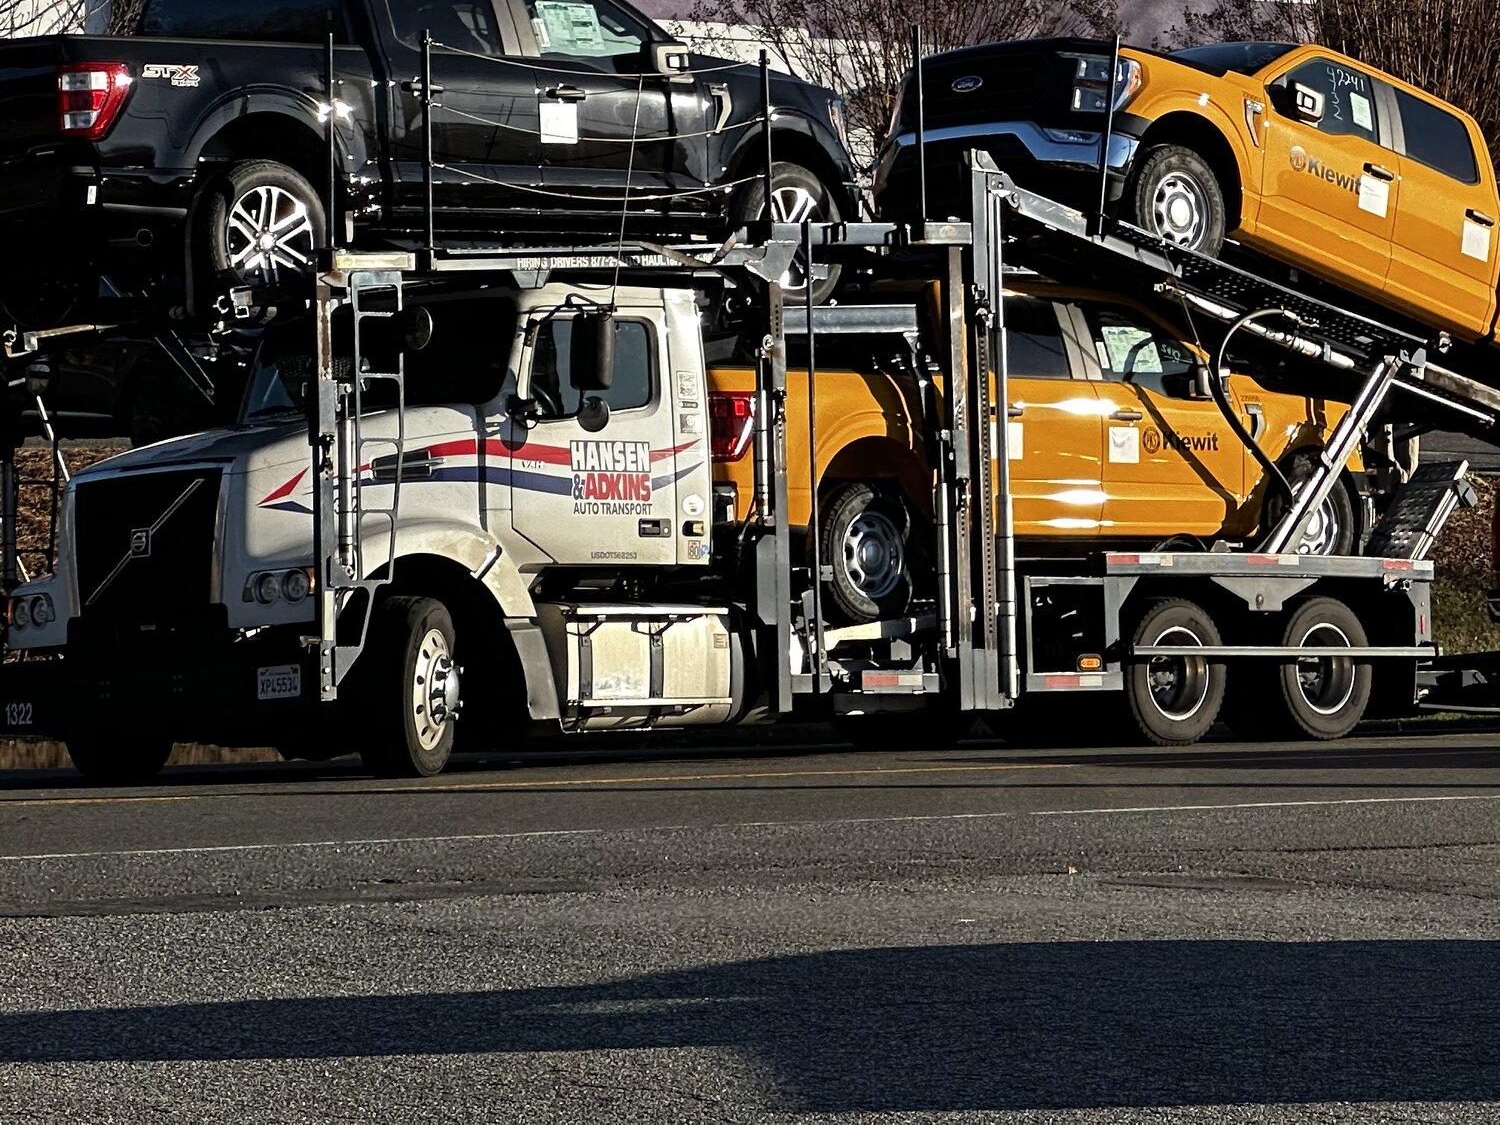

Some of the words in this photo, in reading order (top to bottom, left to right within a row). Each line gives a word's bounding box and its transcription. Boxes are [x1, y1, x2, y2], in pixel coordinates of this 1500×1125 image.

[142, 64, 201, 81] STX
[1307, 156, 1361, 196] Kiewit
[517, 257, 548, 270] HIRING
[550, 256, 589, 269] DRIVERS
[642, 254, 666, 267] HAUL
[570, 441, 651, 473] HANSEN
[573, 502, 600, 515] AUTO
[601, 503, 652, 516] TRANSPORT
[5, 702, 33, 725] 1322
